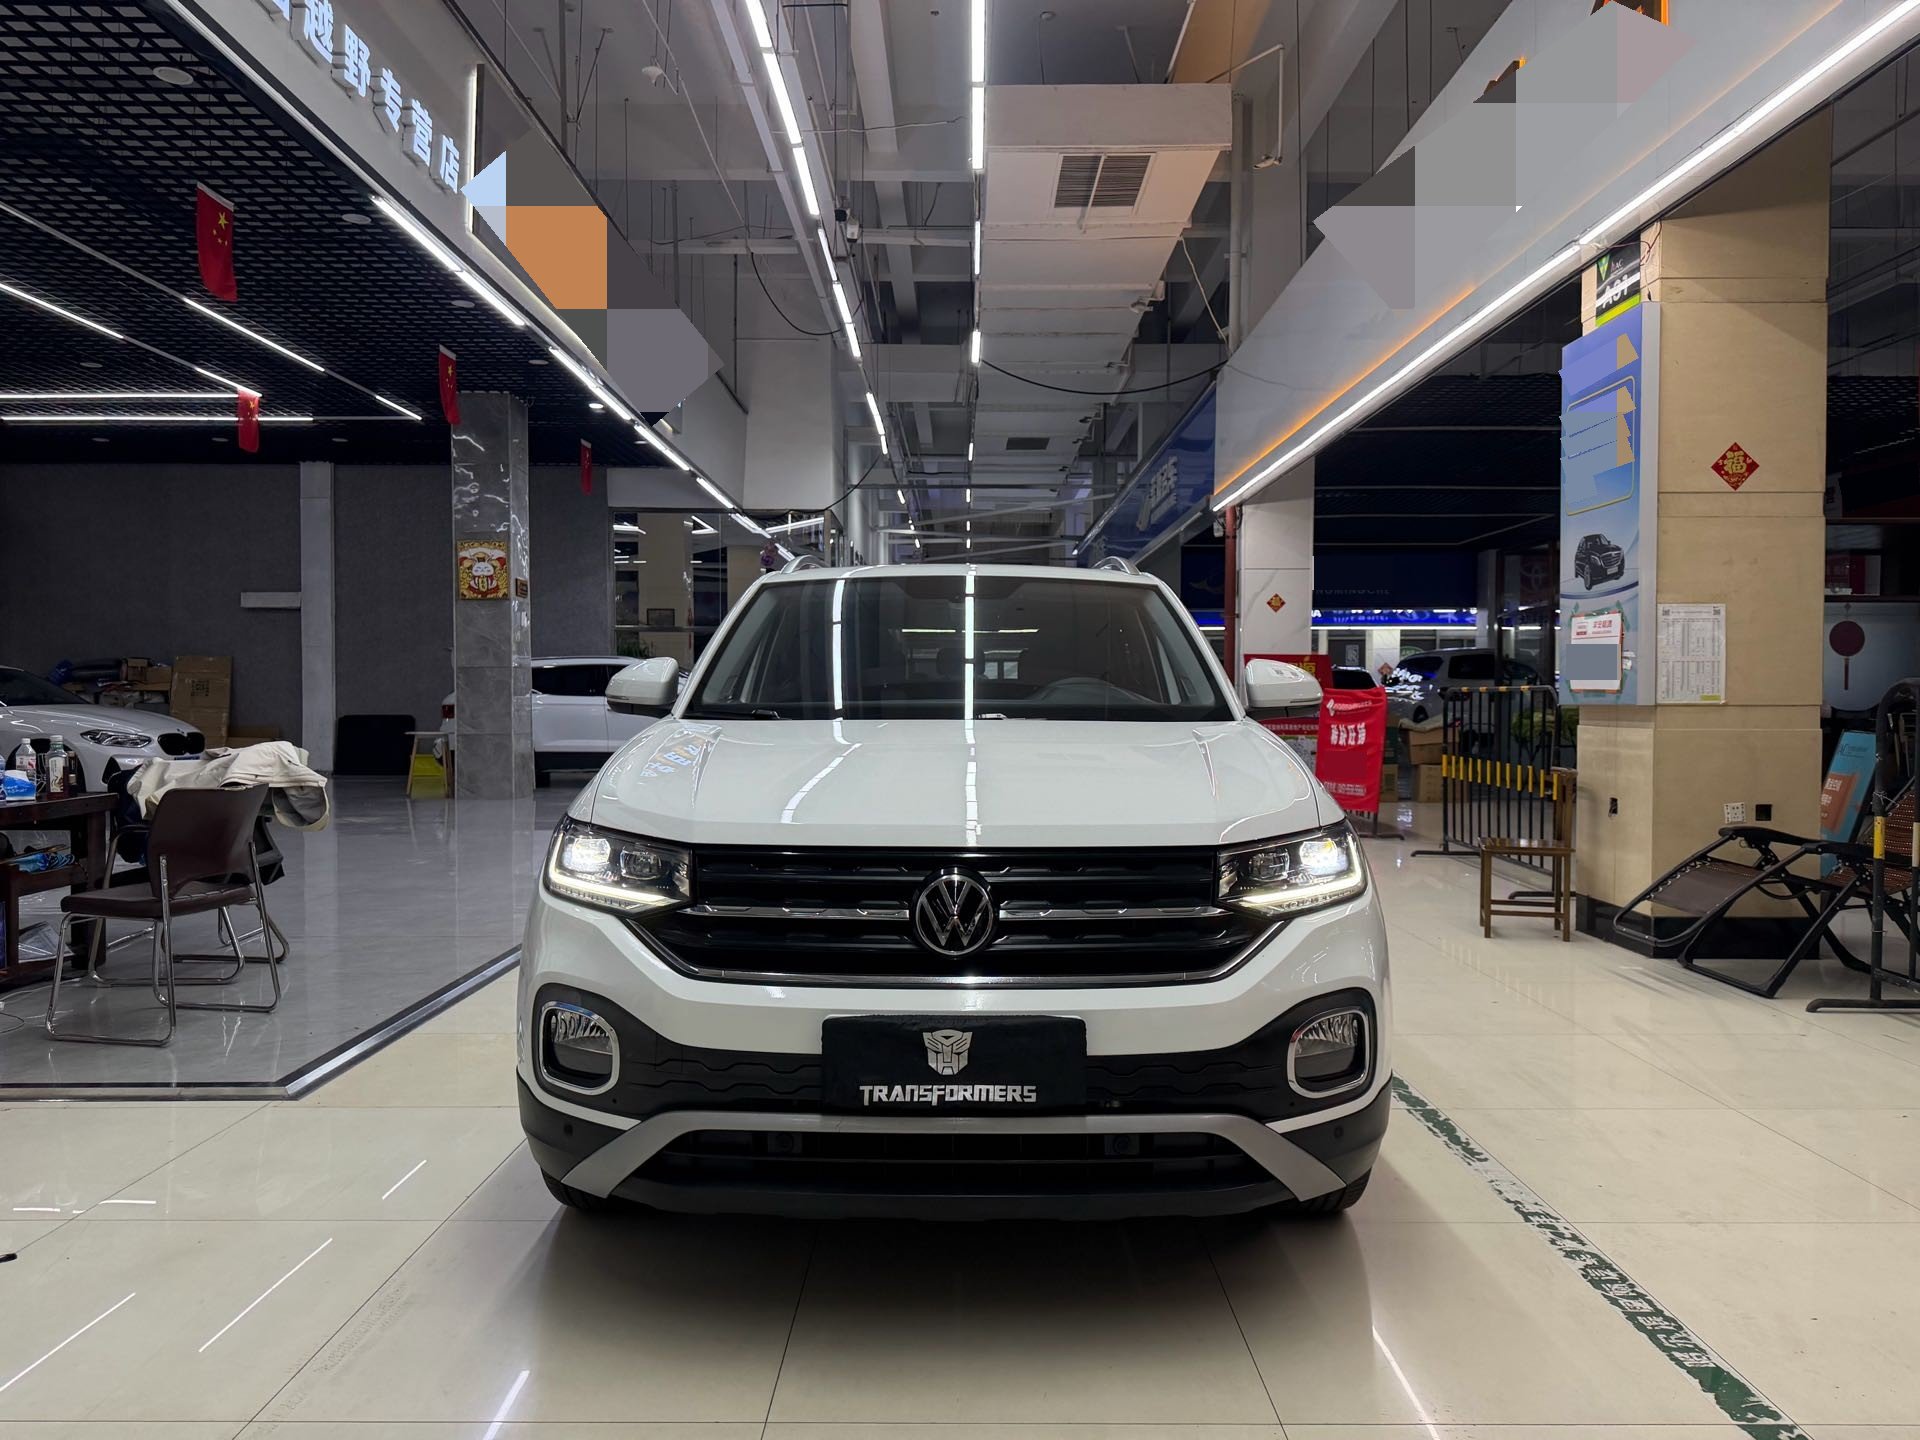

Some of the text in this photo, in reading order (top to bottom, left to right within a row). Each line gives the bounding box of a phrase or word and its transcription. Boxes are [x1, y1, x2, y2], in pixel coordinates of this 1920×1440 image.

[271, 0, 460, 194] 越野专营店
[1723, 450, 1747, 474] 福
[859, 1084, 1037, 1106] TRANSFORMERS
